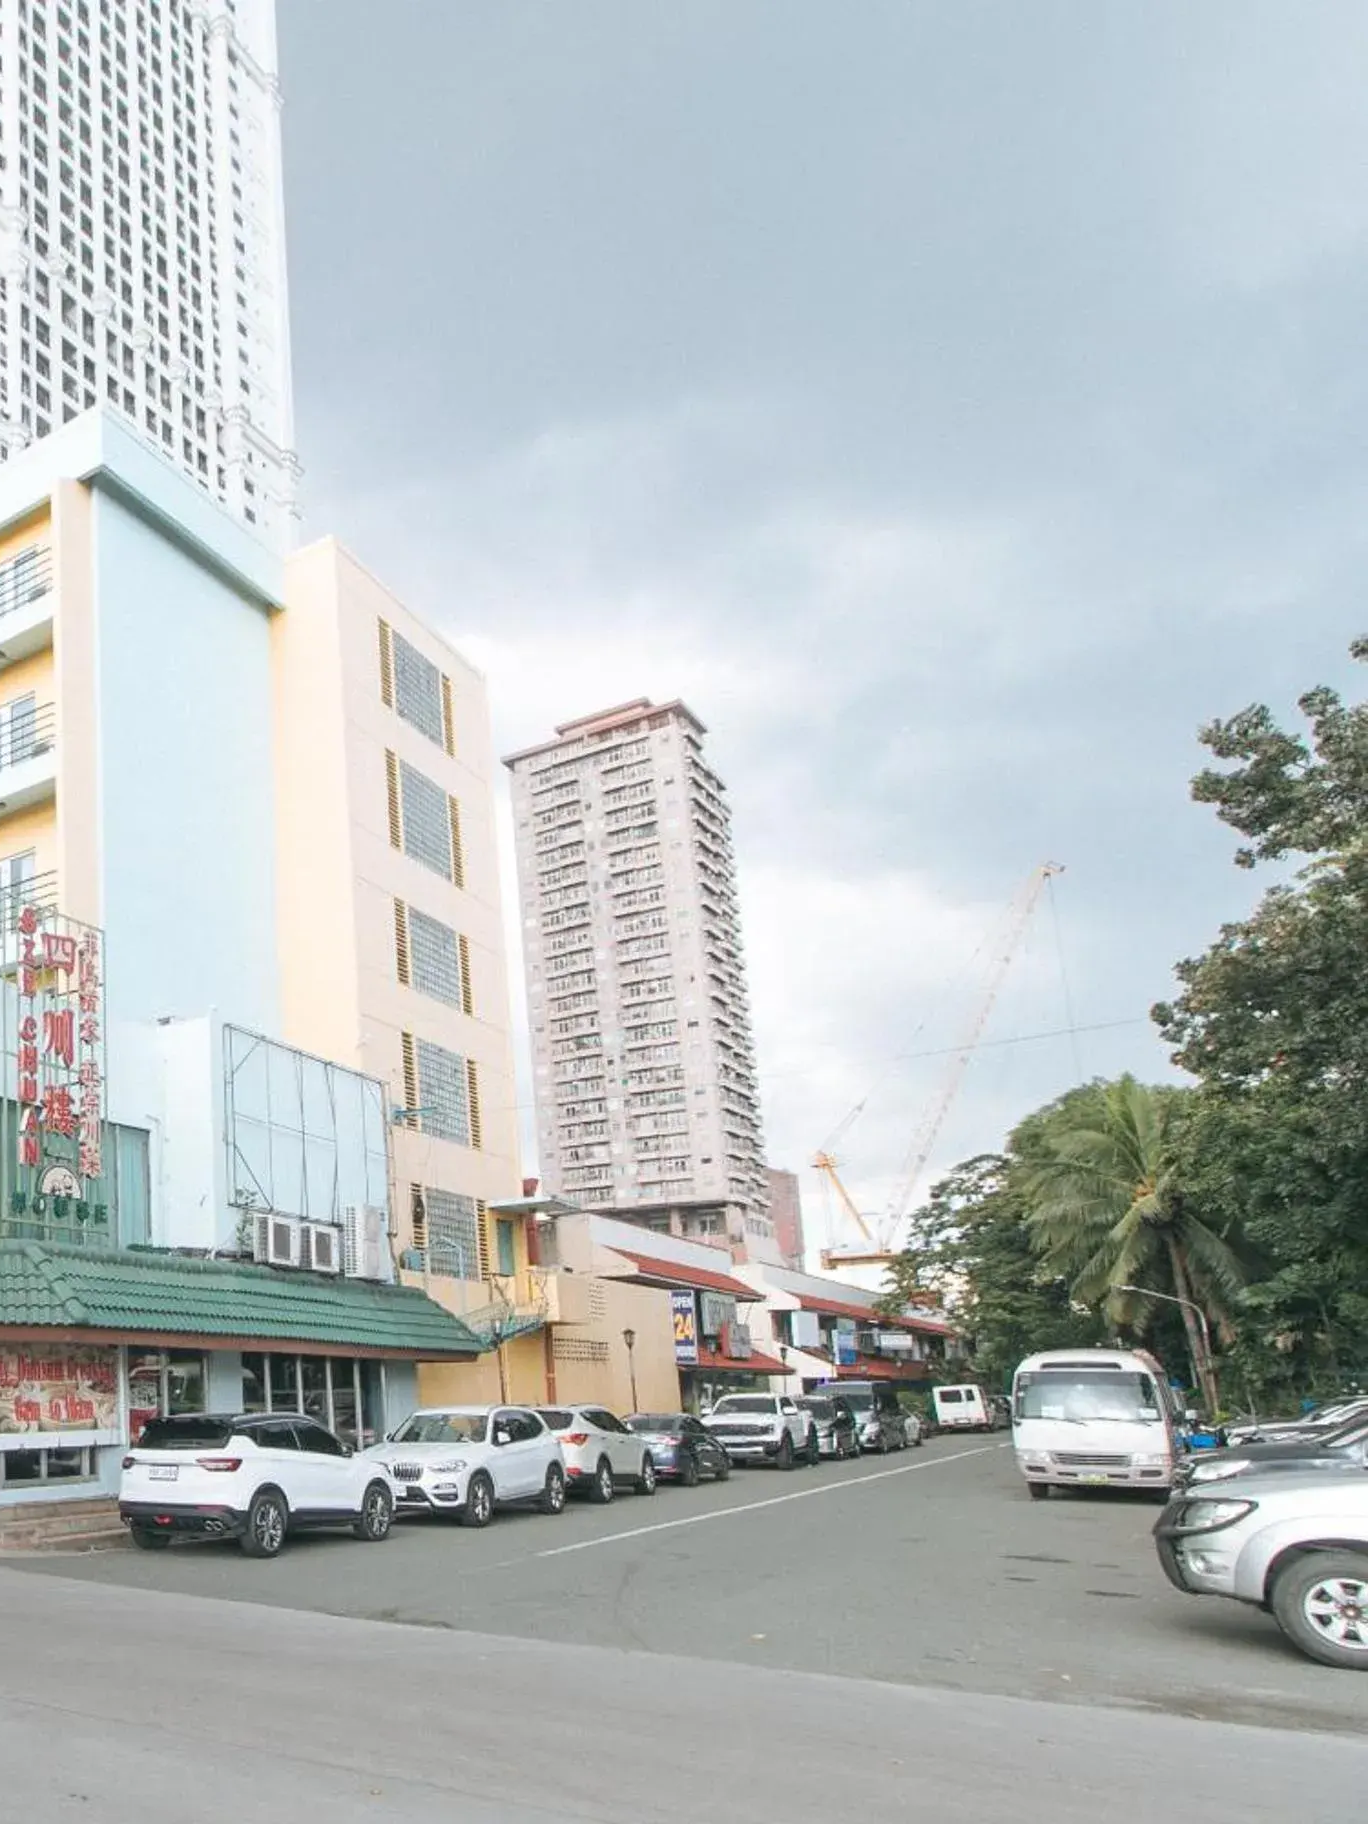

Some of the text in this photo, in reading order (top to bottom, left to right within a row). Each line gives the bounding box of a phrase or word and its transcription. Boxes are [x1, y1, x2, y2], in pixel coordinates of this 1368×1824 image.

[41, 933, 77, 1139] 四川樓
[12, 1192, 108, 1224] HOUSE
[674, 1313, 695, 1341] 24
